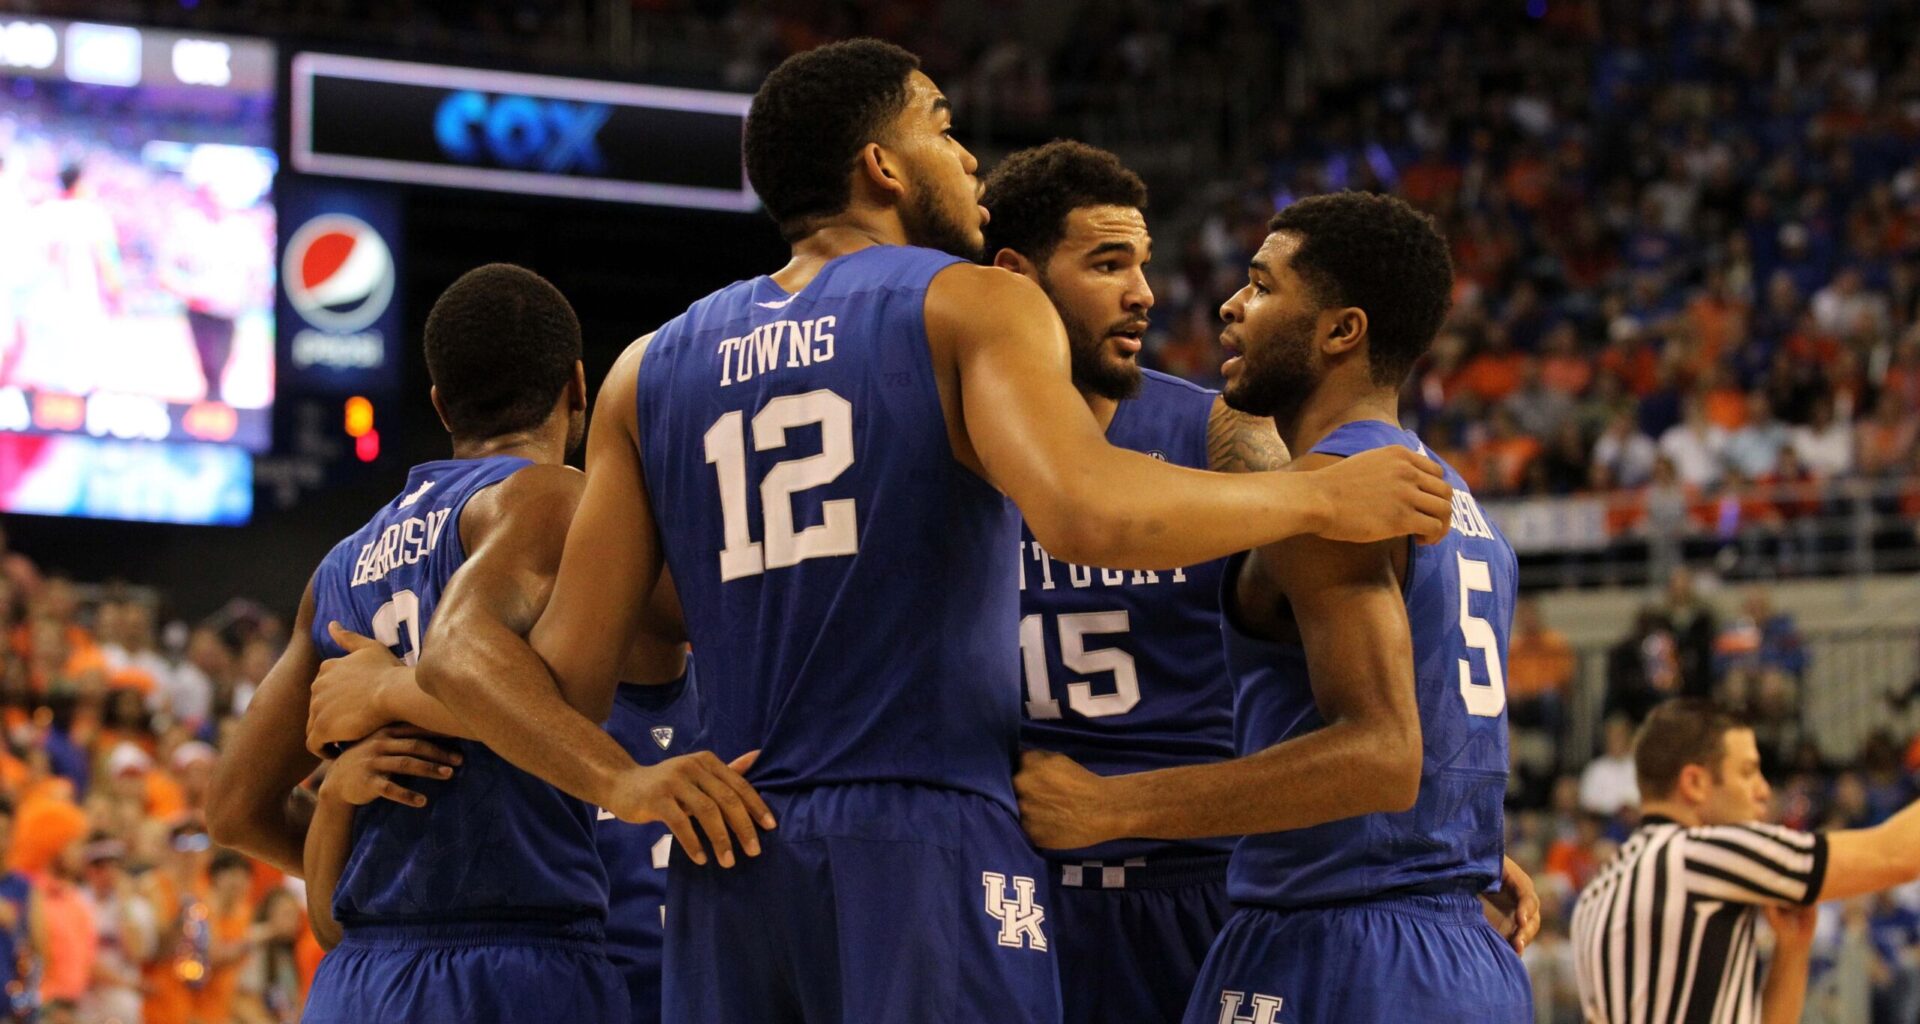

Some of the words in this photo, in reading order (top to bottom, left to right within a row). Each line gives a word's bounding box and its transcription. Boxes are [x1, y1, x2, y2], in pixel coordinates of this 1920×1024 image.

[718, 315, 836, 386] TOWNS
[704, 388, 858, 583] 12
[1019, 610, 1141, 719] 15
[1457, 550, 1506, 717] 5
[982, 871, 1047, 952] UK
